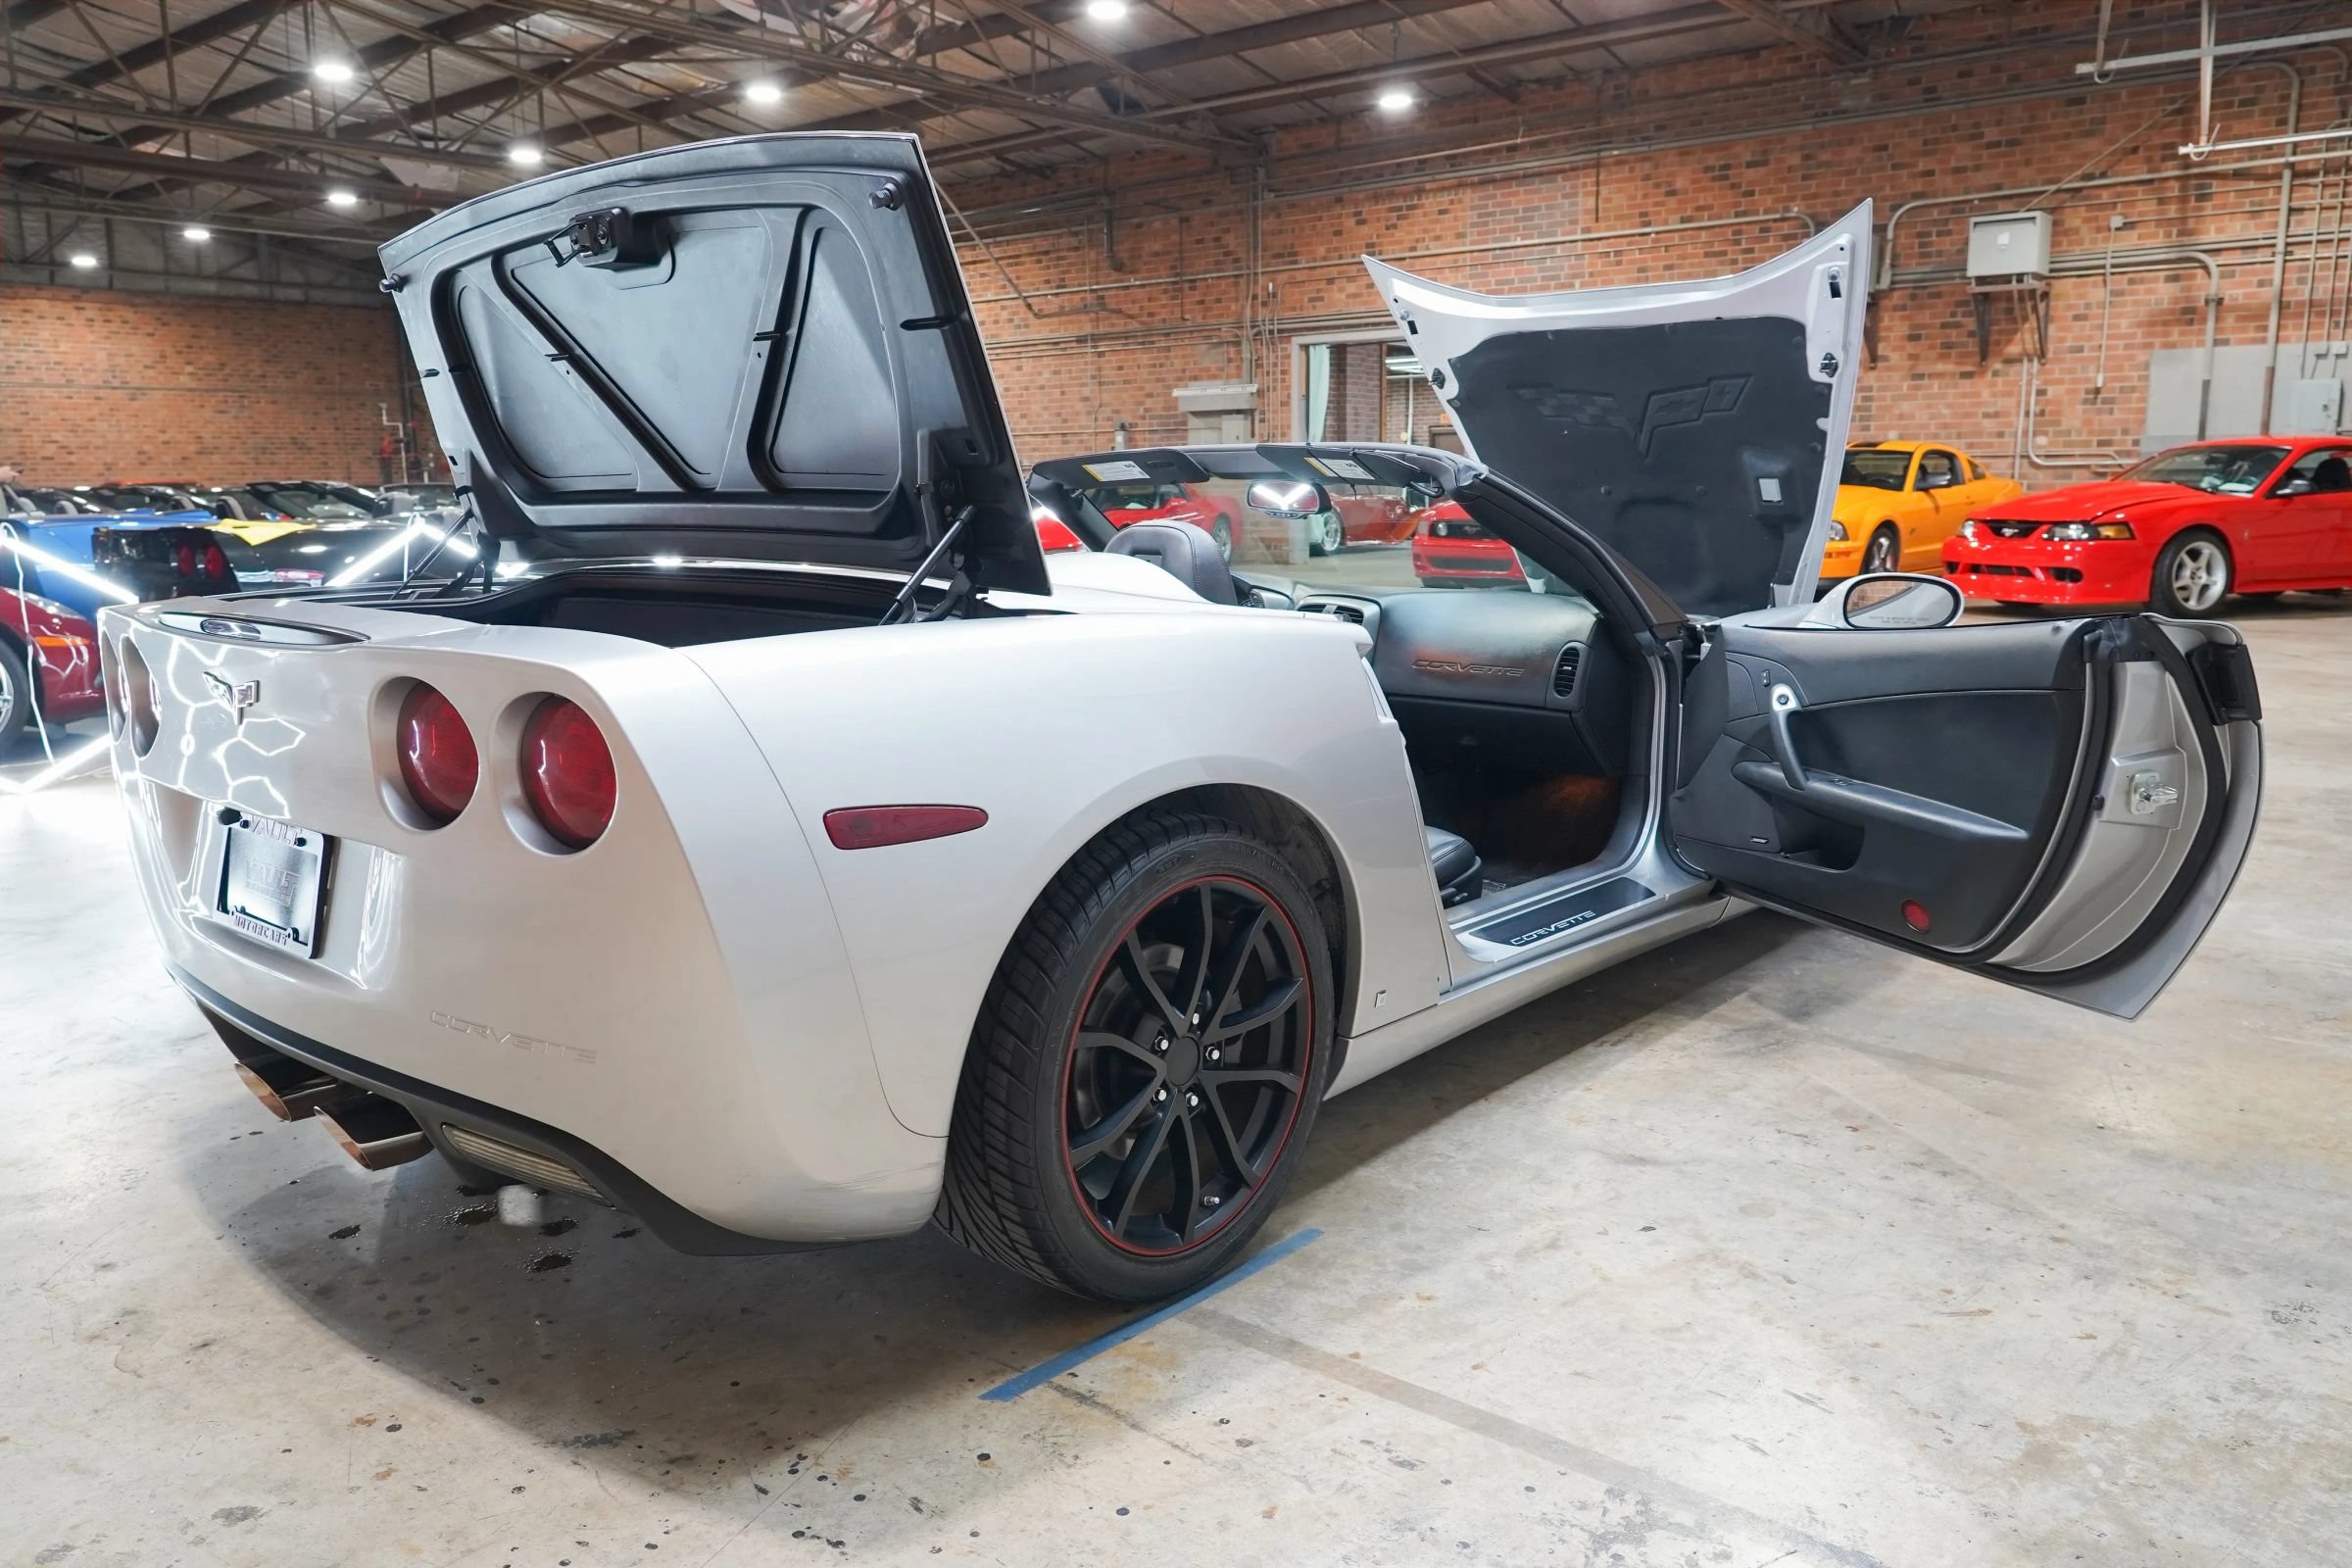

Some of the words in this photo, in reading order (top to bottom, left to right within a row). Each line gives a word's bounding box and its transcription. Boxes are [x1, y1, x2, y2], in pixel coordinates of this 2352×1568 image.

[1411, 660, 1525, 677] CORVETTE
[249, 814, 303, 847] VAULT
[1510, 909, 1596, 947] CORVETTE
[431, 1009, 598, 1065] CORVETTE
